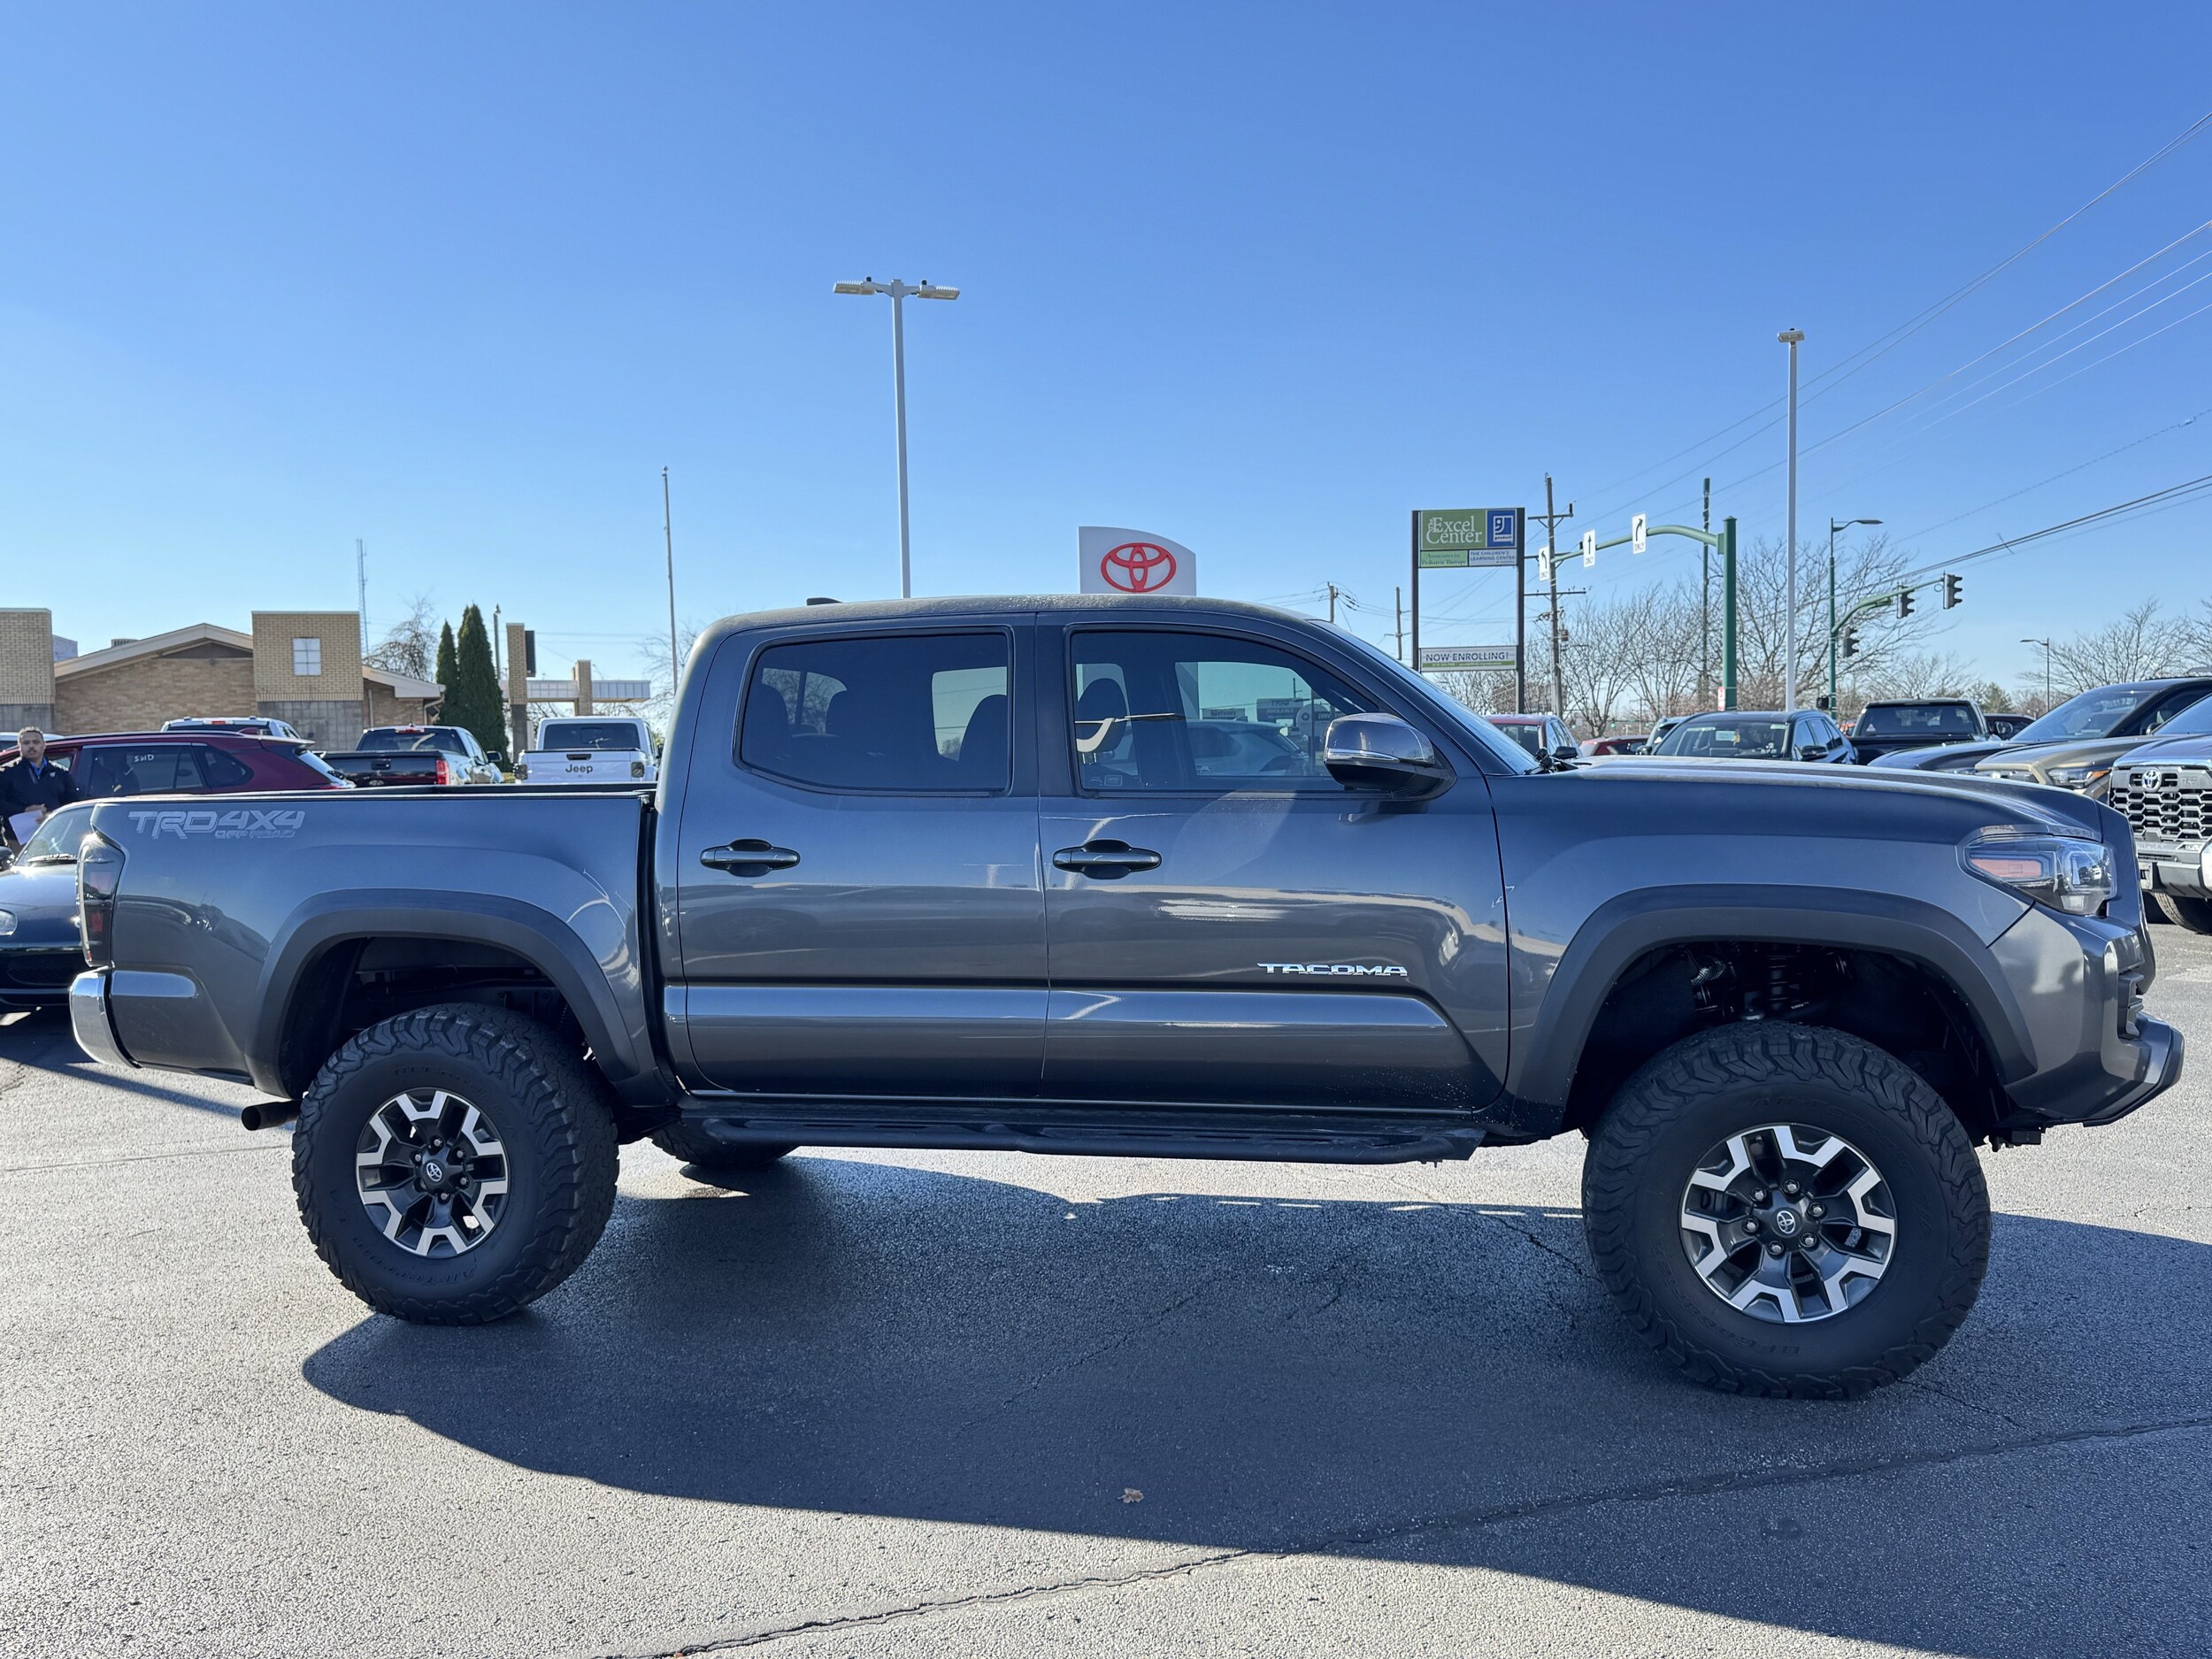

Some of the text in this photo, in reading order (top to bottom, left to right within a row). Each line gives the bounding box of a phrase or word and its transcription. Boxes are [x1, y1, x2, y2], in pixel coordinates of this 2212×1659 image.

[1432, 516, 1476, 533] Excel
[1426, 529, 1482, 544] Center
[1453, 652, 1509, 661] ENROLLING!
[565, 764, 594, 774] Jeep
[1256, 963, 1408, 977] TACOMA
